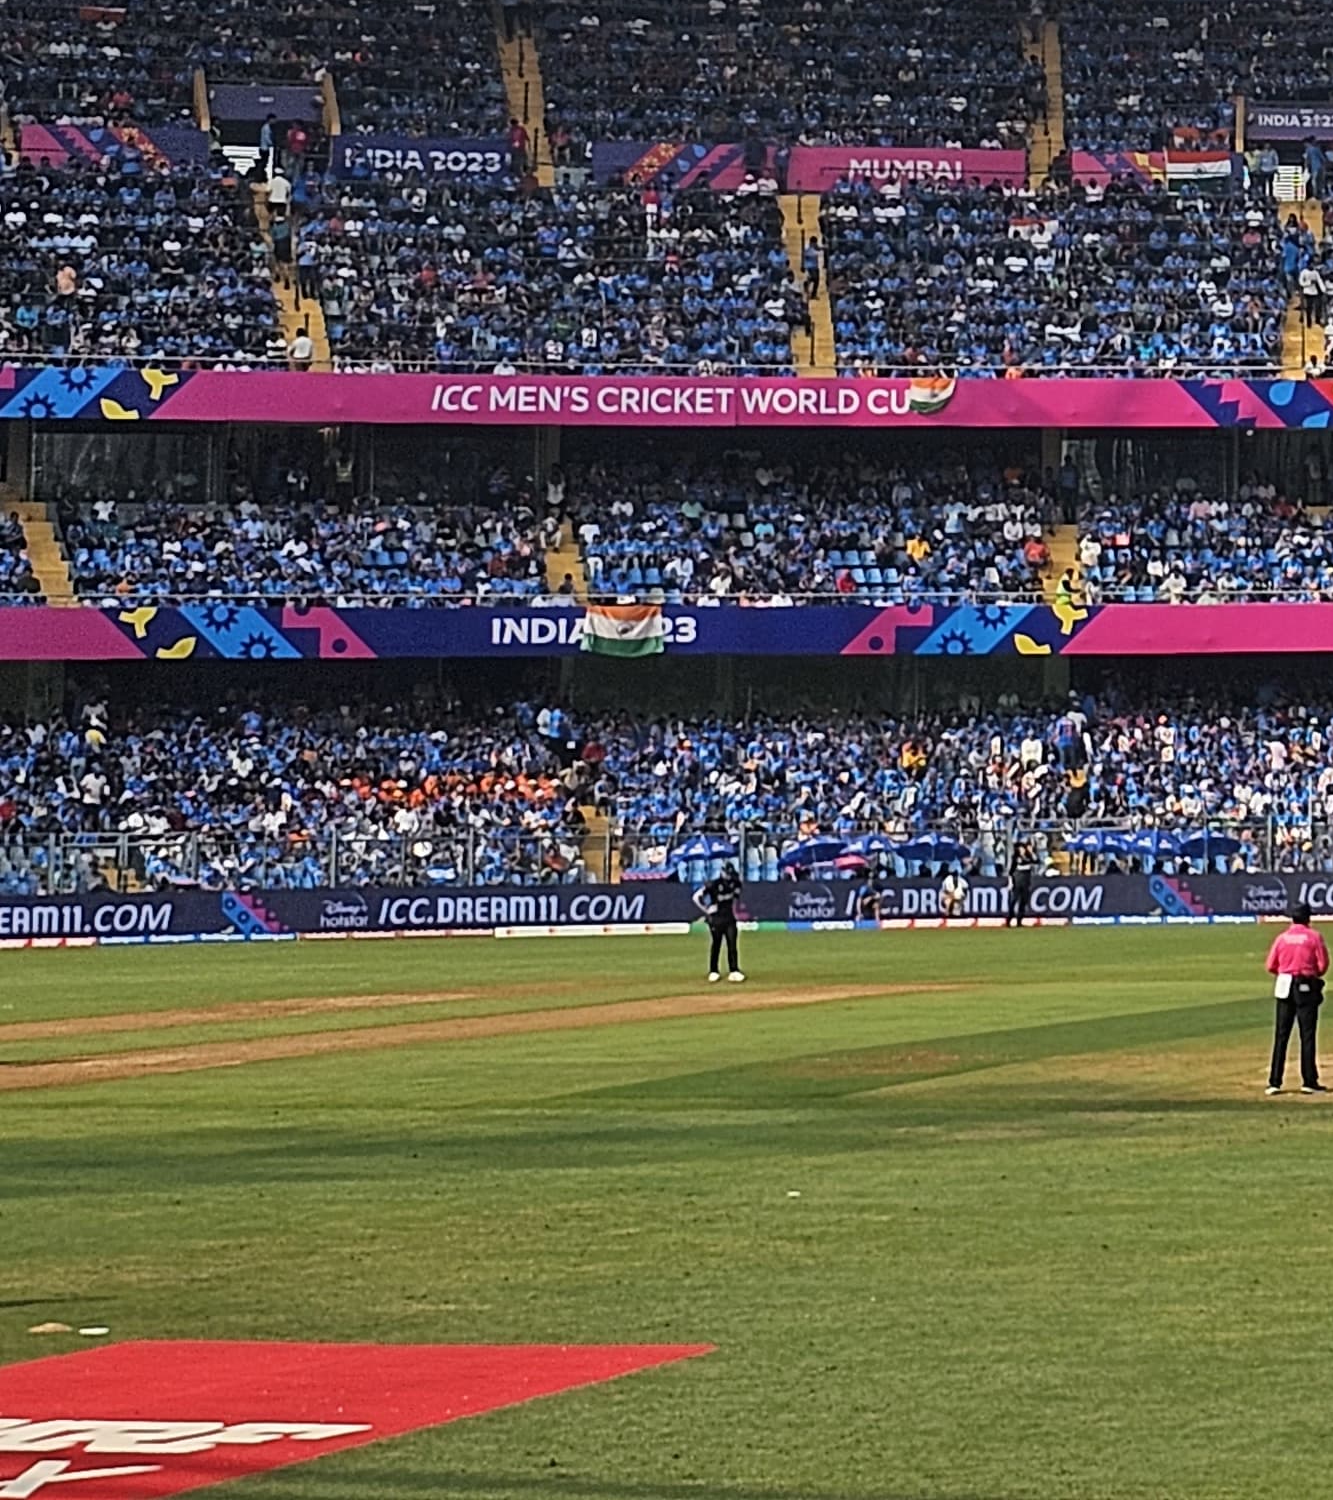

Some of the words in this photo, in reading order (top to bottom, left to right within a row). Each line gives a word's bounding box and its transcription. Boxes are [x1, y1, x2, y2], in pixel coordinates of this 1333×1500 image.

[429, 151, 501, 173] 2023
[431, 385, 483, 411] ICC
[489, 384, 589, 411] MEN'S
[597, 386, 734, 414] CRICKET
[741, 387, 859, 414] WORLD
[867, 388, 911, 415] CU
[492, 617, 586, 644] INDIA
[320, 914, 368, 927] hotstar
[789, 905, 835, 918] hotstar
